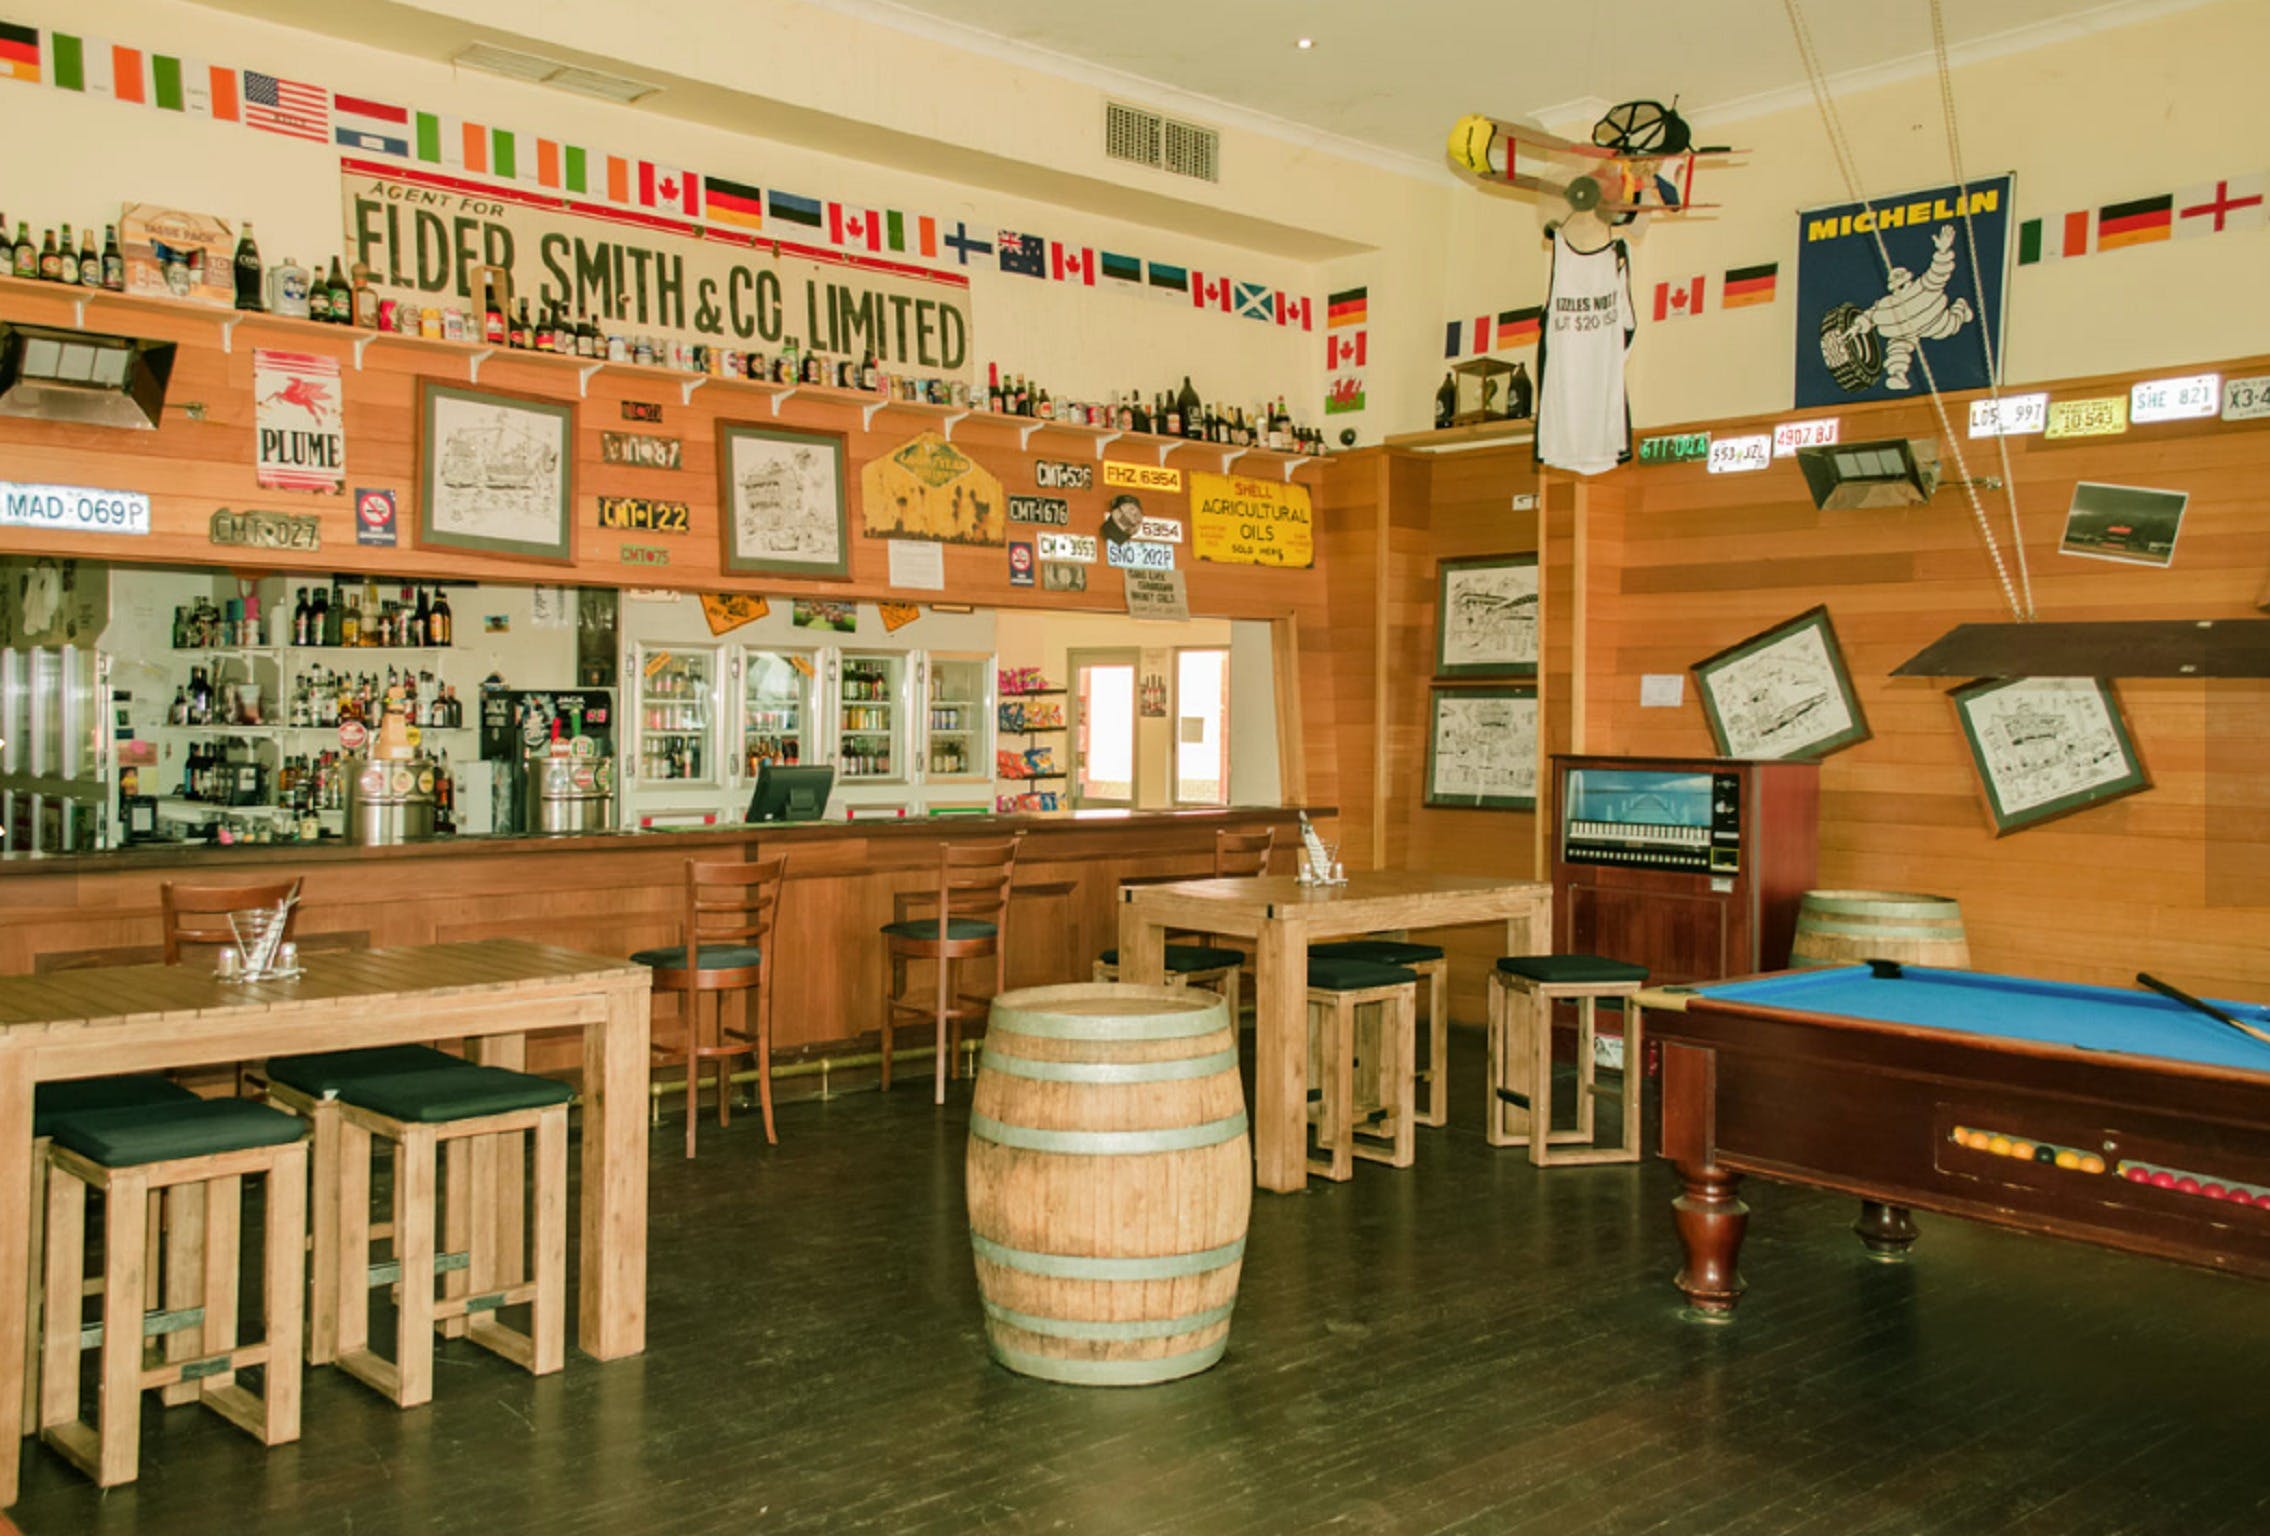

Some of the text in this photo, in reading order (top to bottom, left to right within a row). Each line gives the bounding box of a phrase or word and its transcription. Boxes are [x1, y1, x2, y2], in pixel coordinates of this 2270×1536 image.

[370, 180, 505, 218] AGENT FOR
[1808, 189, 1999, 242] MICHELIN
[355, 198, 515, 300] ELDER
[806, 279, 966, 370] LIMITED
[2178, 385, 2210, 405] 821
[260, 427, 342, 469] PLUME
[1107, 465, 1178, 487] FHZ 6354
[1234, 482, 1273, 499] SHELL
[1201, 498, 1310, 524] AGRICULTURAL
[1142, 521, 1180, 538] 6354
[1239, 523, 1275, 541] OILS
